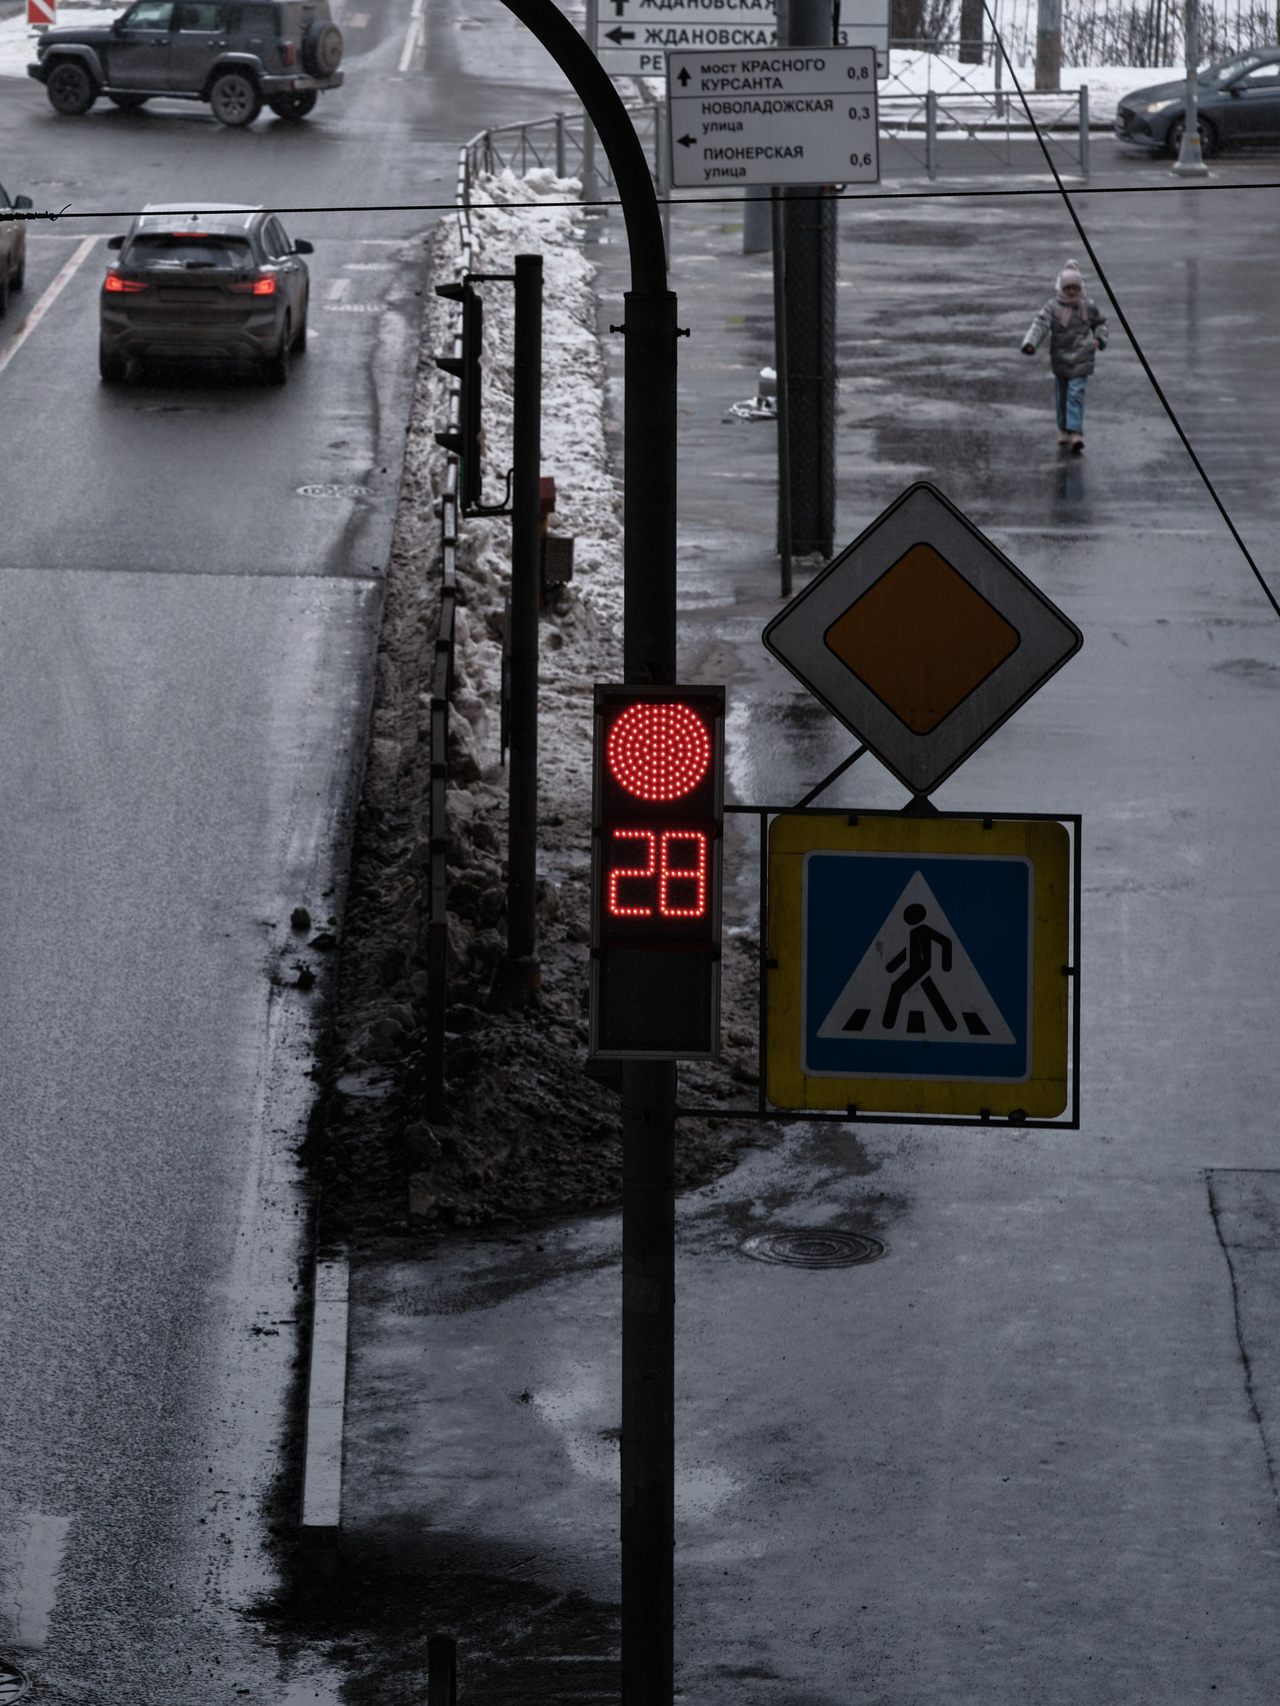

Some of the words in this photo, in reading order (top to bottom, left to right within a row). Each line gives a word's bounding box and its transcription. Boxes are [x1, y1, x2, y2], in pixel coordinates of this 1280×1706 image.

[700, 64, 737, 74] мост
[741, 59, 826, 73] КРАСНОГО
[847, 66, 869, 81] 0,8
[701, 77, 784, 91] КУРСАНТА
[702, 99, 834, 115] НОВОЛАДОЖСКАЯ
[848, 107, 870, 122] 0,3
[702, 121, 744, 135] улица
[703, 146, 804, 160] ПИОНЕРСКАЯ
[850, 153, 872, 167] 0,6
[704, 167, 747, 180] улица
[609, 828, 707, 917] 28
